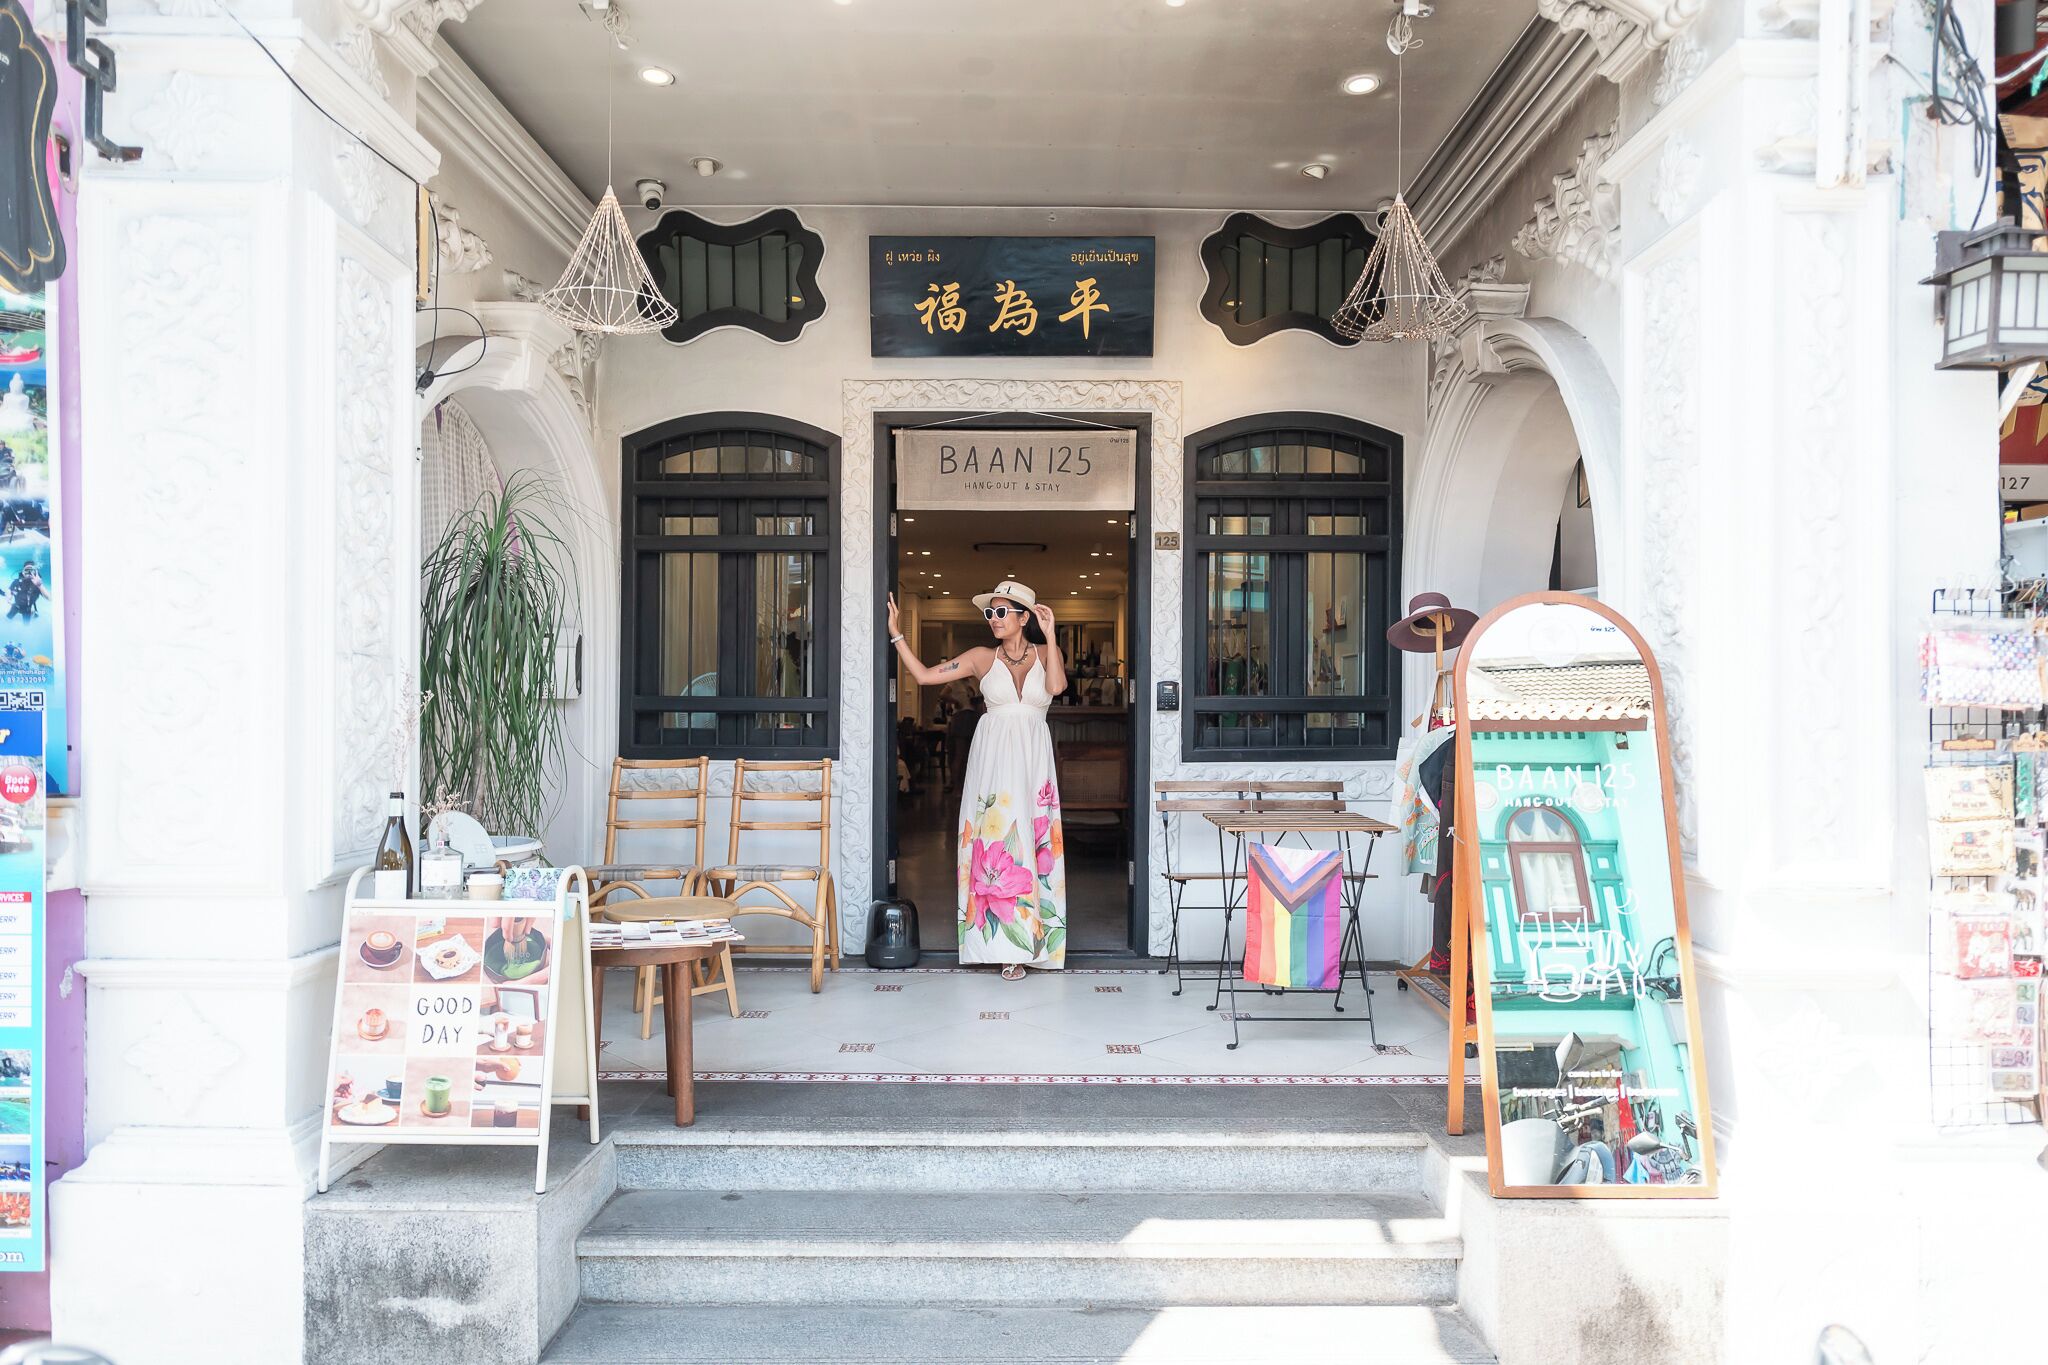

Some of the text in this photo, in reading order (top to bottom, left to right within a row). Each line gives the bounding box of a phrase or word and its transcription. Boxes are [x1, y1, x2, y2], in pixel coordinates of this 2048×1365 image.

[1071, 249, 1139, 266] อยู่เย็นเป็นสุข
[940, 445, 1092, 475] BAAN 125
[964, 481, 1061, 492] HANGOUT & STAY
[2001, 476, 2030, 490] 127
[1156, 536, 1178, 547] 125
[5, 775, 30, 784] Book
[1496, 763, 1637, 791] BAAN 125
[6, 784, 30, 794] Here
[1504, 797, 1573, 808] HANGOUT
[416, 997, 473, 1016] GOOD
[422, 1024, 463, 1044] DAY
[1512, 1086, 1567, 1099] beverages
